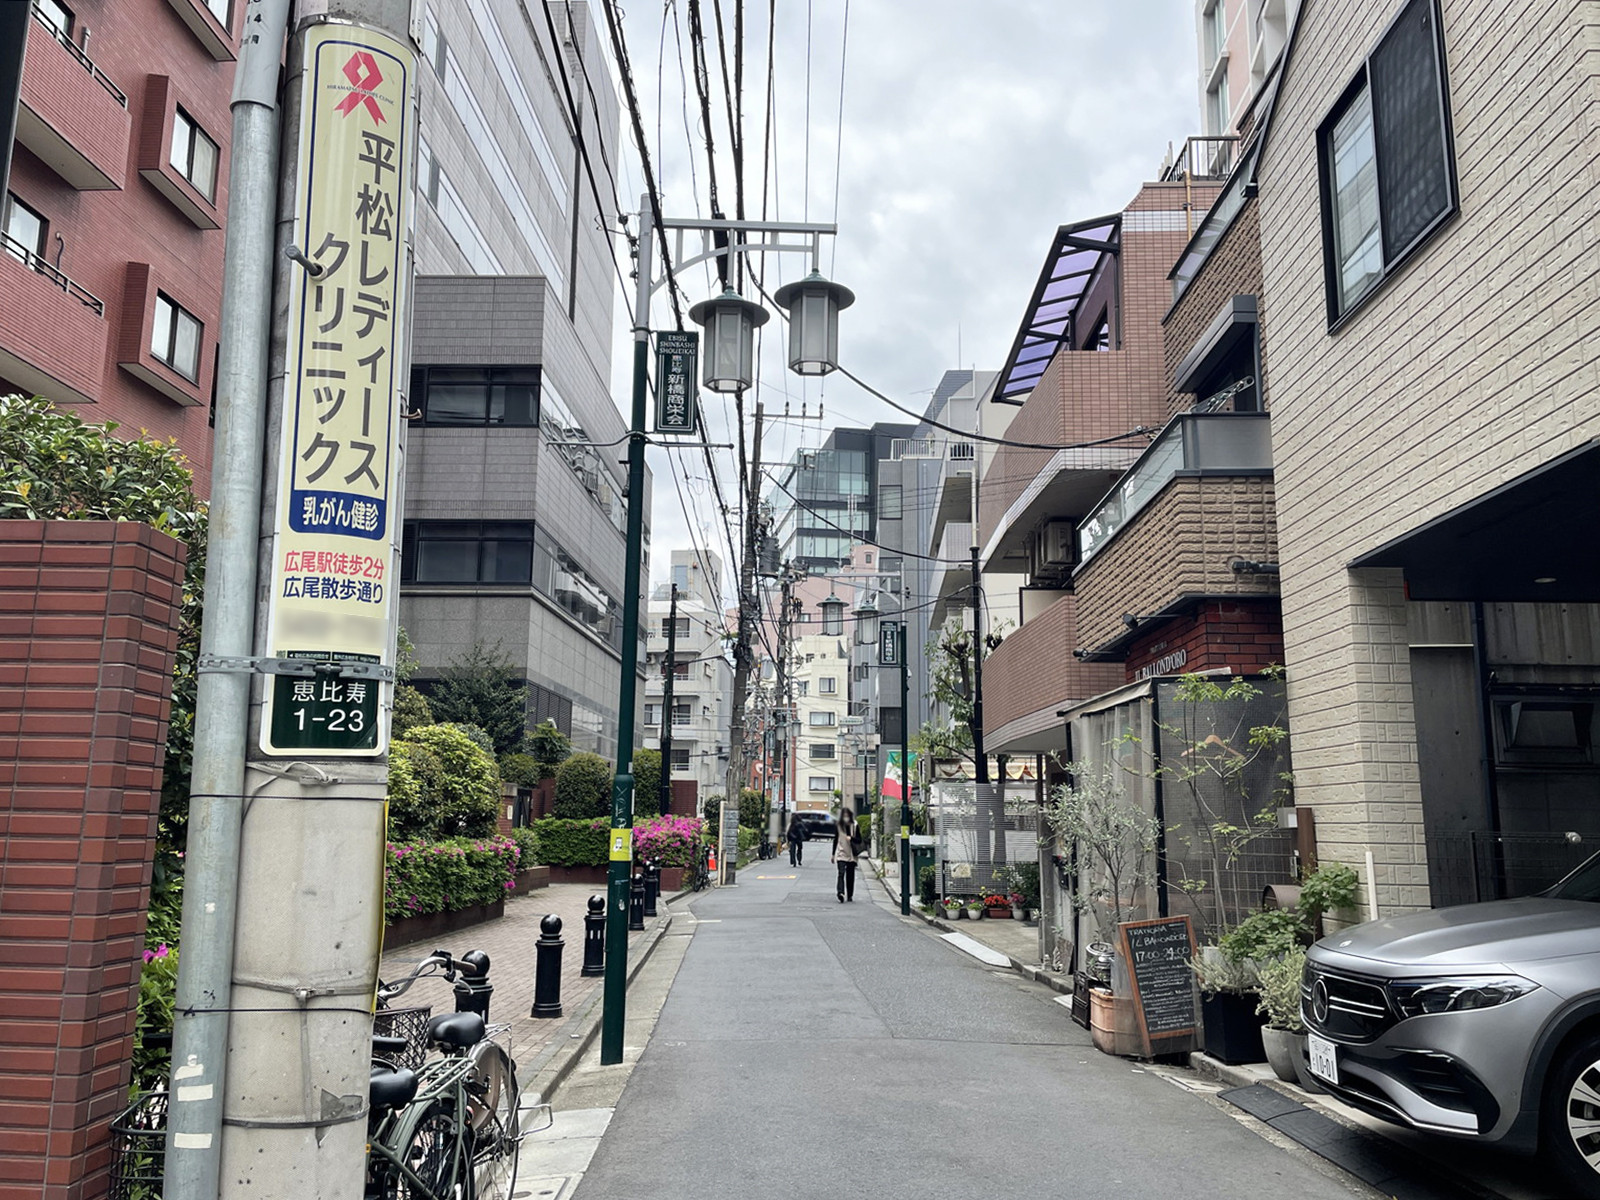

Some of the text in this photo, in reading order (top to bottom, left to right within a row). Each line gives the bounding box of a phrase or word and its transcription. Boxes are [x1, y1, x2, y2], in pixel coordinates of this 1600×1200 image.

[344, 130, 396, 490] 平松レディース
[668, 334, 687, 342] EBISU
[301, 232, 350, 485] クリニック
[302, 496, 379, 532] 乳がん健診
[283, 550, 385, 581] 広尾駅徒歩2分
[282, 576, 384, 604] 広尾散歩通り
[292, 680, 367, 704] 恵比寿
[293, 707, 365, 733] 1-23
